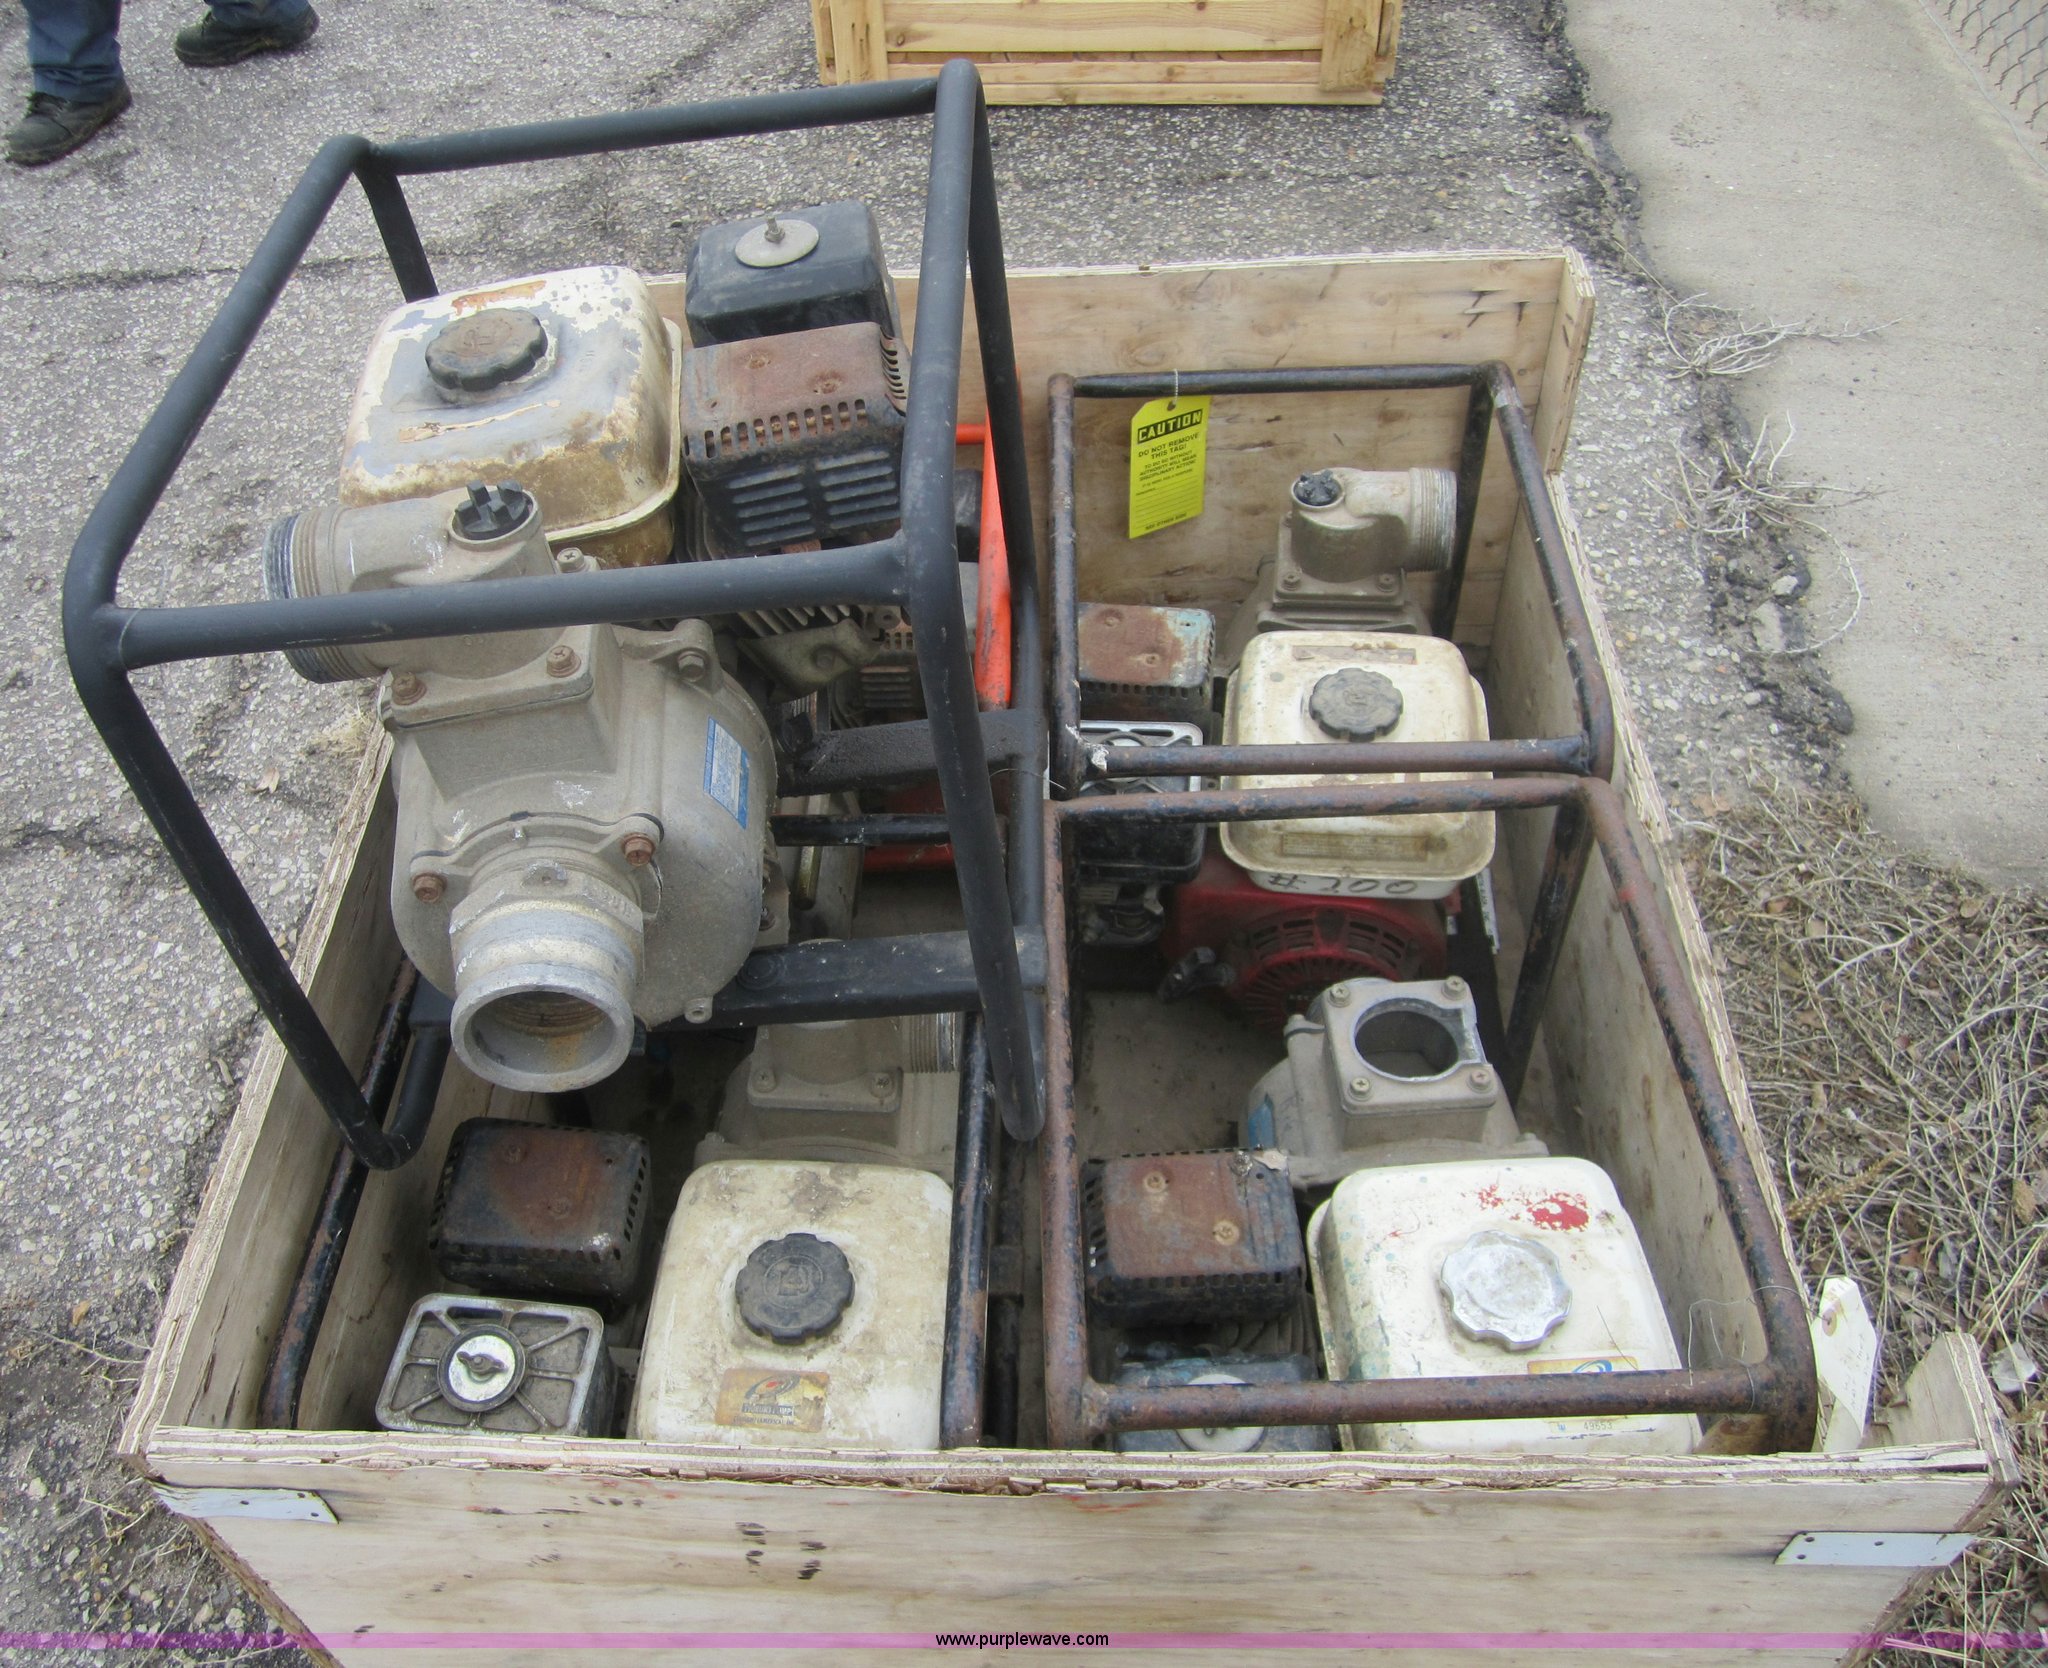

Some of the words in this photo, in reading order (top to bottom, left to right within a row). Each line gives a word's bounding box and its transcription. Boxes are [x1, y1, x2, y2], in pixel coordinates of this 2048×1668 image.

[1139, 410, 1201, 441] CAUTION
[1138, 449, 1149, 457] DO
[1152, 443, 1166, 453] NOT
[1168, 432, 1199, 447] REMOVE
[1151, 450, 1168, 459] THIS
